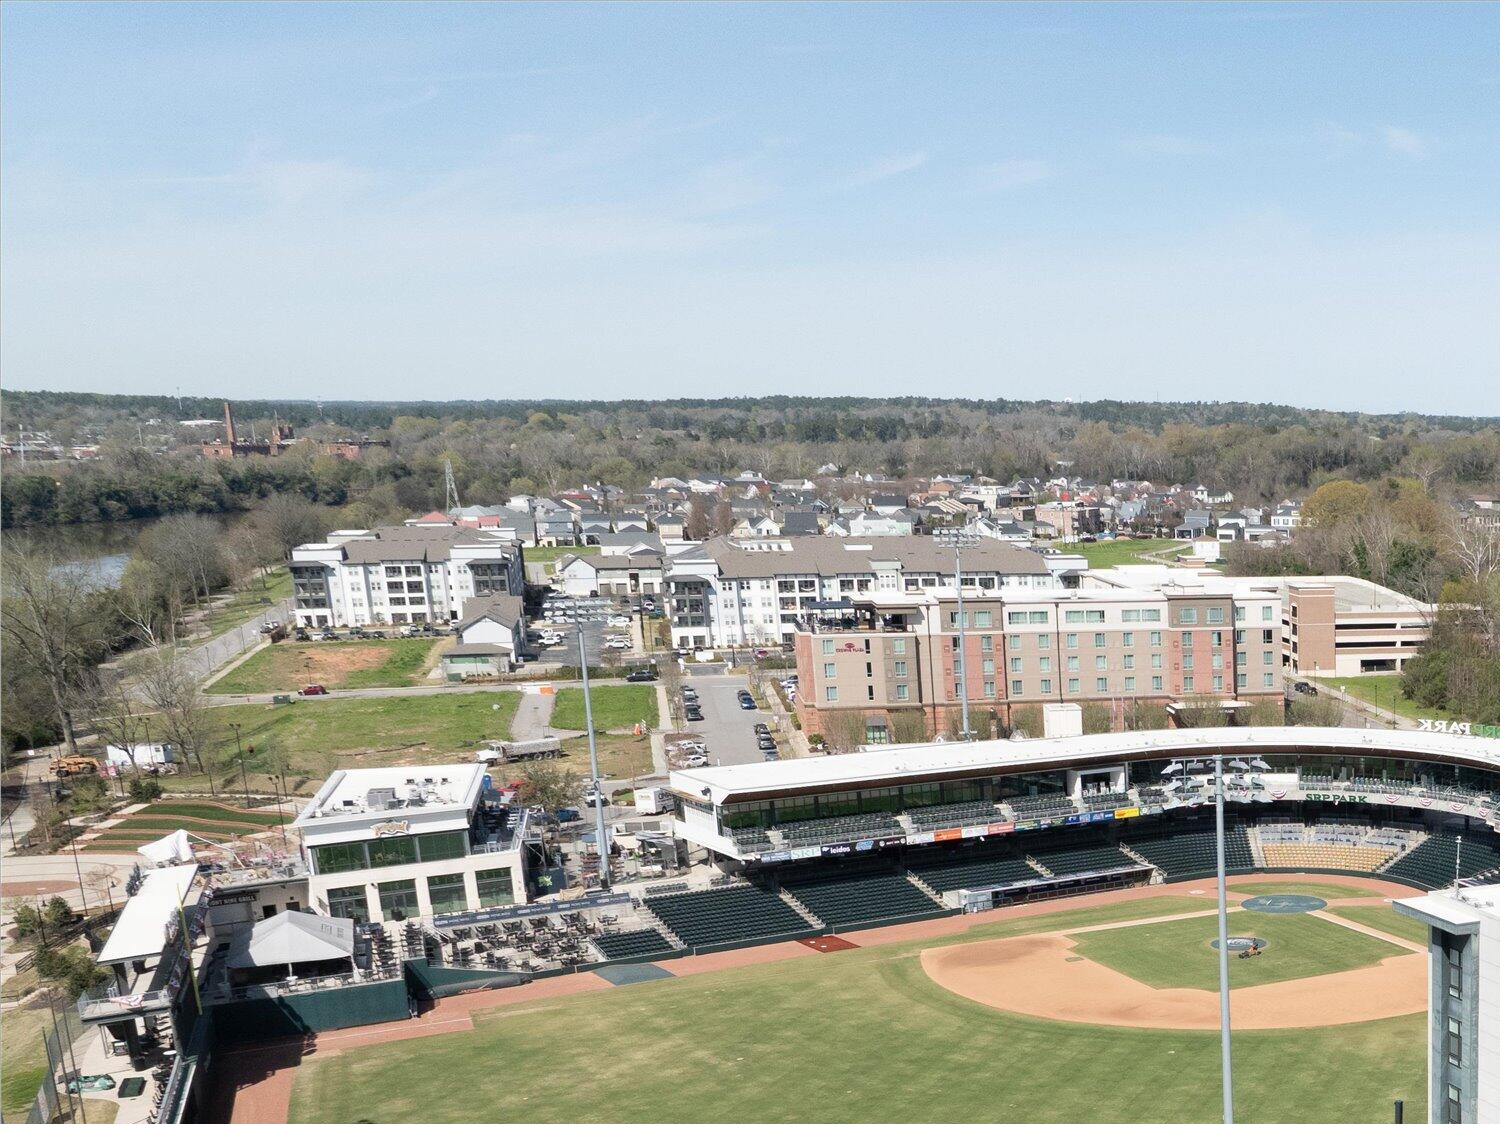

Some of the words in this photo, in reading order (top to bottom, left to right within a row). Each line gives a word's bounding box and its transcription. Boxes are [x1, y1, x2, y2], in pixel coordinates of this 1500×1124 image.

[1305, 793, 1331, 801] SRP
[1332, 794, 1369, 803] PARK
[830, 845, 851, 854] leidos
